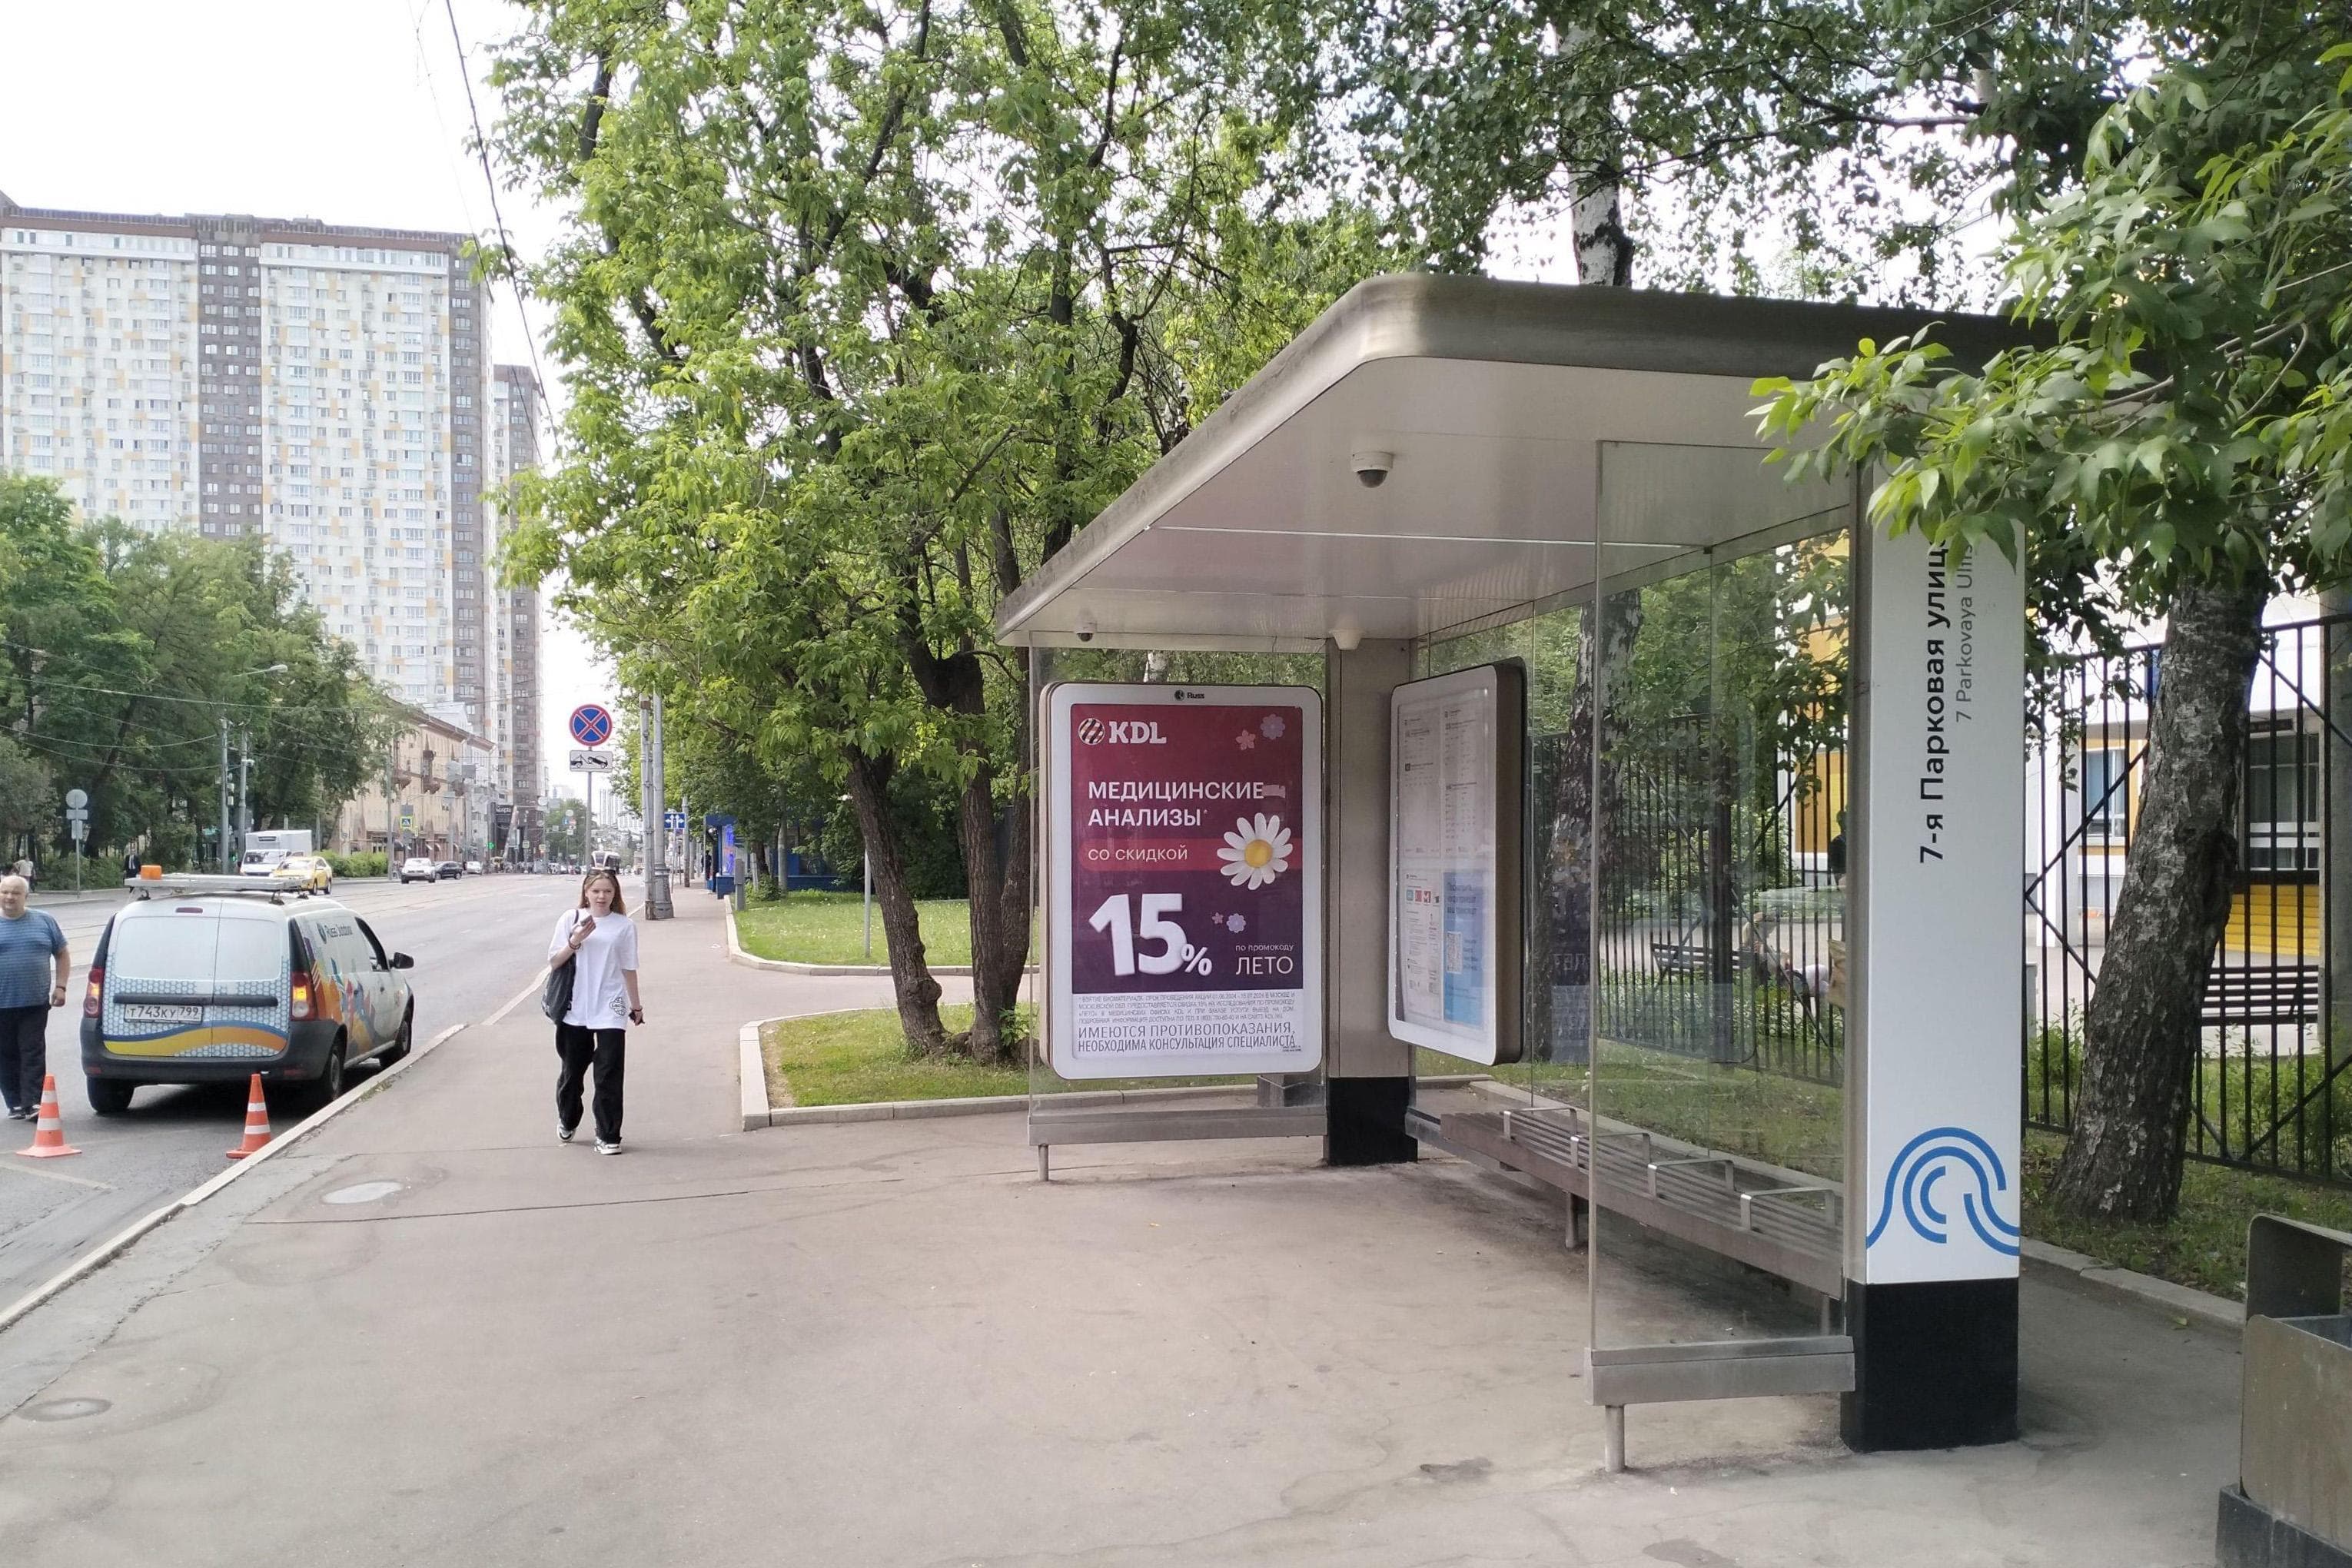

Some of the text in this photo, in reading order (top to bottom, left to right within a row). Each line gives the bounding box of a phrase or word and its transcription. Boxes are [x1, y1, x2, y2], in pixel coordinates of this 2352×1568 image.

[1956, 596, 1976, 703] Parkovaya
[1920, 540, 1951, 864] 7-я Парковая улиц
[1956, 710, 1972, 723] 7
[1108, 721, 1167, 744] KDL
[1088, 781, 1264, 802] МЕДИЦИНСКИЕ
[1088, 893, 1212, 976] 15%
[1248, 944, 1294, 952] промокоду
[1235, 956, 1294, 975] ЛЕТО
[179, 1006, 199, 1017] 799
[1078, 1025, 1146, 1038] ИМЕЮТСЯ
[1078, 1039, 1147, 1052] НЕОБХОДИМА
[1149, 1036, 1224, 1050] КОНСУЛЬТАЦИЯ
[1227, 1035, 1295, 1049] СПЕЦИАЛИСТА
